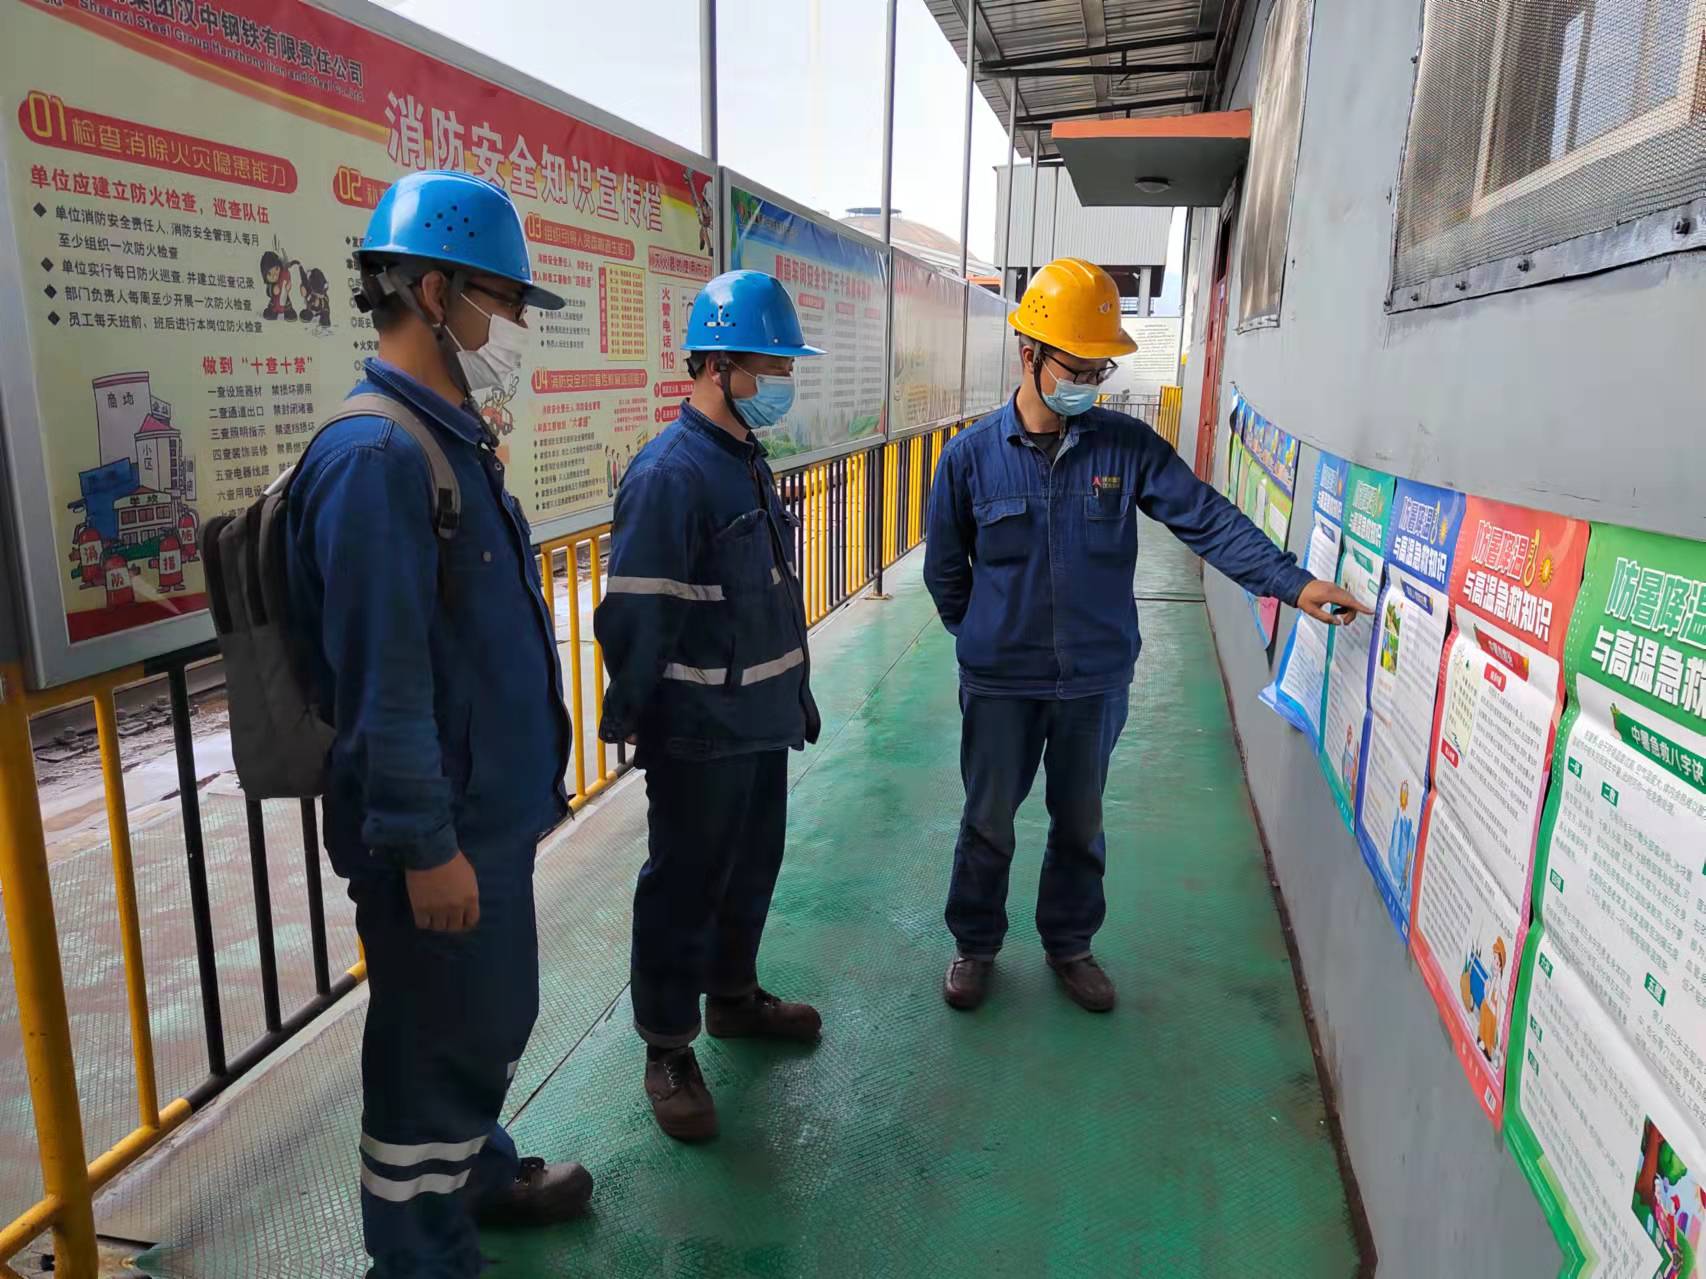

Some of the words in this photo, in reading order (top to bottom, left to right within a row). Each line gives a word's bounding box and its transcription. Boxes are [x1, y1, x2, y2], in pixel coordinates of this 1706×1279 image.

[384, 91, 664, 232] 消防安全知识宣传栏
[58, 232, 178, 260] 至少组织一次防火检查
[661, 351, 675, 370] 119
[1471, 519, 1530, 580] 防暑降温
[1463, 568, 1552, 642] 与高温急救知识
[1631, 725, 1705, 787] 中暑急救八字诀
